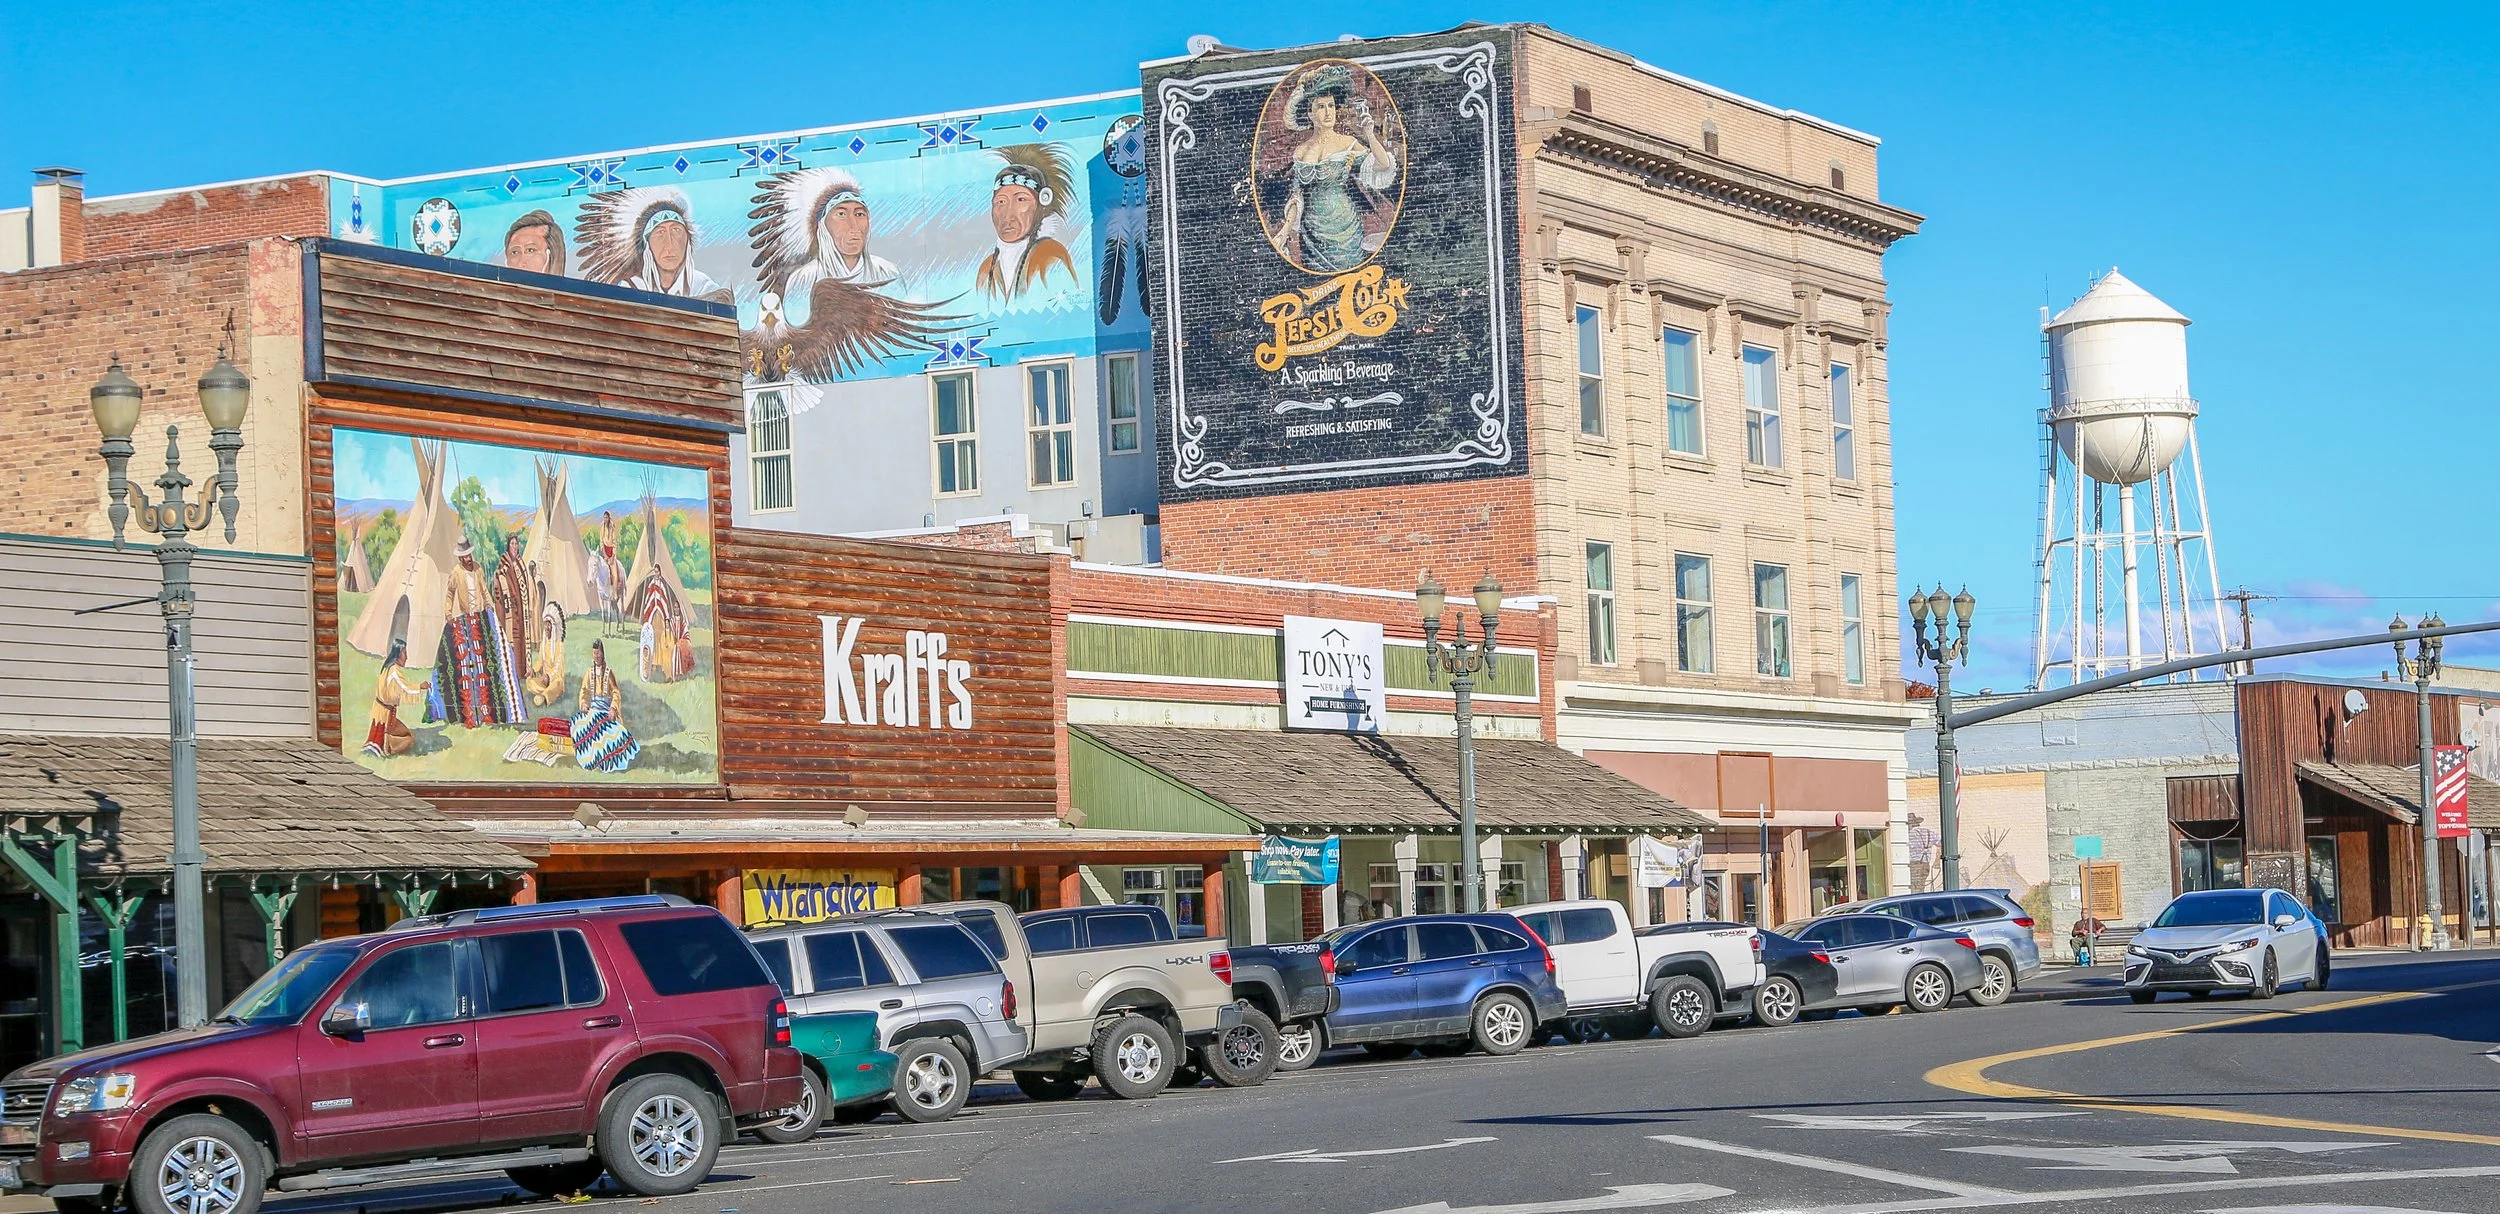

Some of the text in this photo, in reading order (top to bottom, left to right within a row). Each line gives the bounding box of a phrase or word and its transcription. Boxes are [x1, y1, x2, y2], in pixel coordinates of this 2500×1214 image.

[1312, 280, 1338, 300] DRINK
[1367, 312, 1385, 326] 5¢
[1280, 361, 1398, 388] A Sparkling Beverage
[1286, 418, 1392, 439] REFRESHING & SATISFYING
[817, 615, 972, 729] Kraffs
[1298, 650, 1371, 680] TONY'S
[1320, 683, 1333, 692] NEW
[1312, 700, 1364, 710] HOME FURNISHINGS
[1291, 845, 1304, 858] Pay
[753, 873, 878, 918] Wrangler
[1269, 945, 1297, 954] TRD
